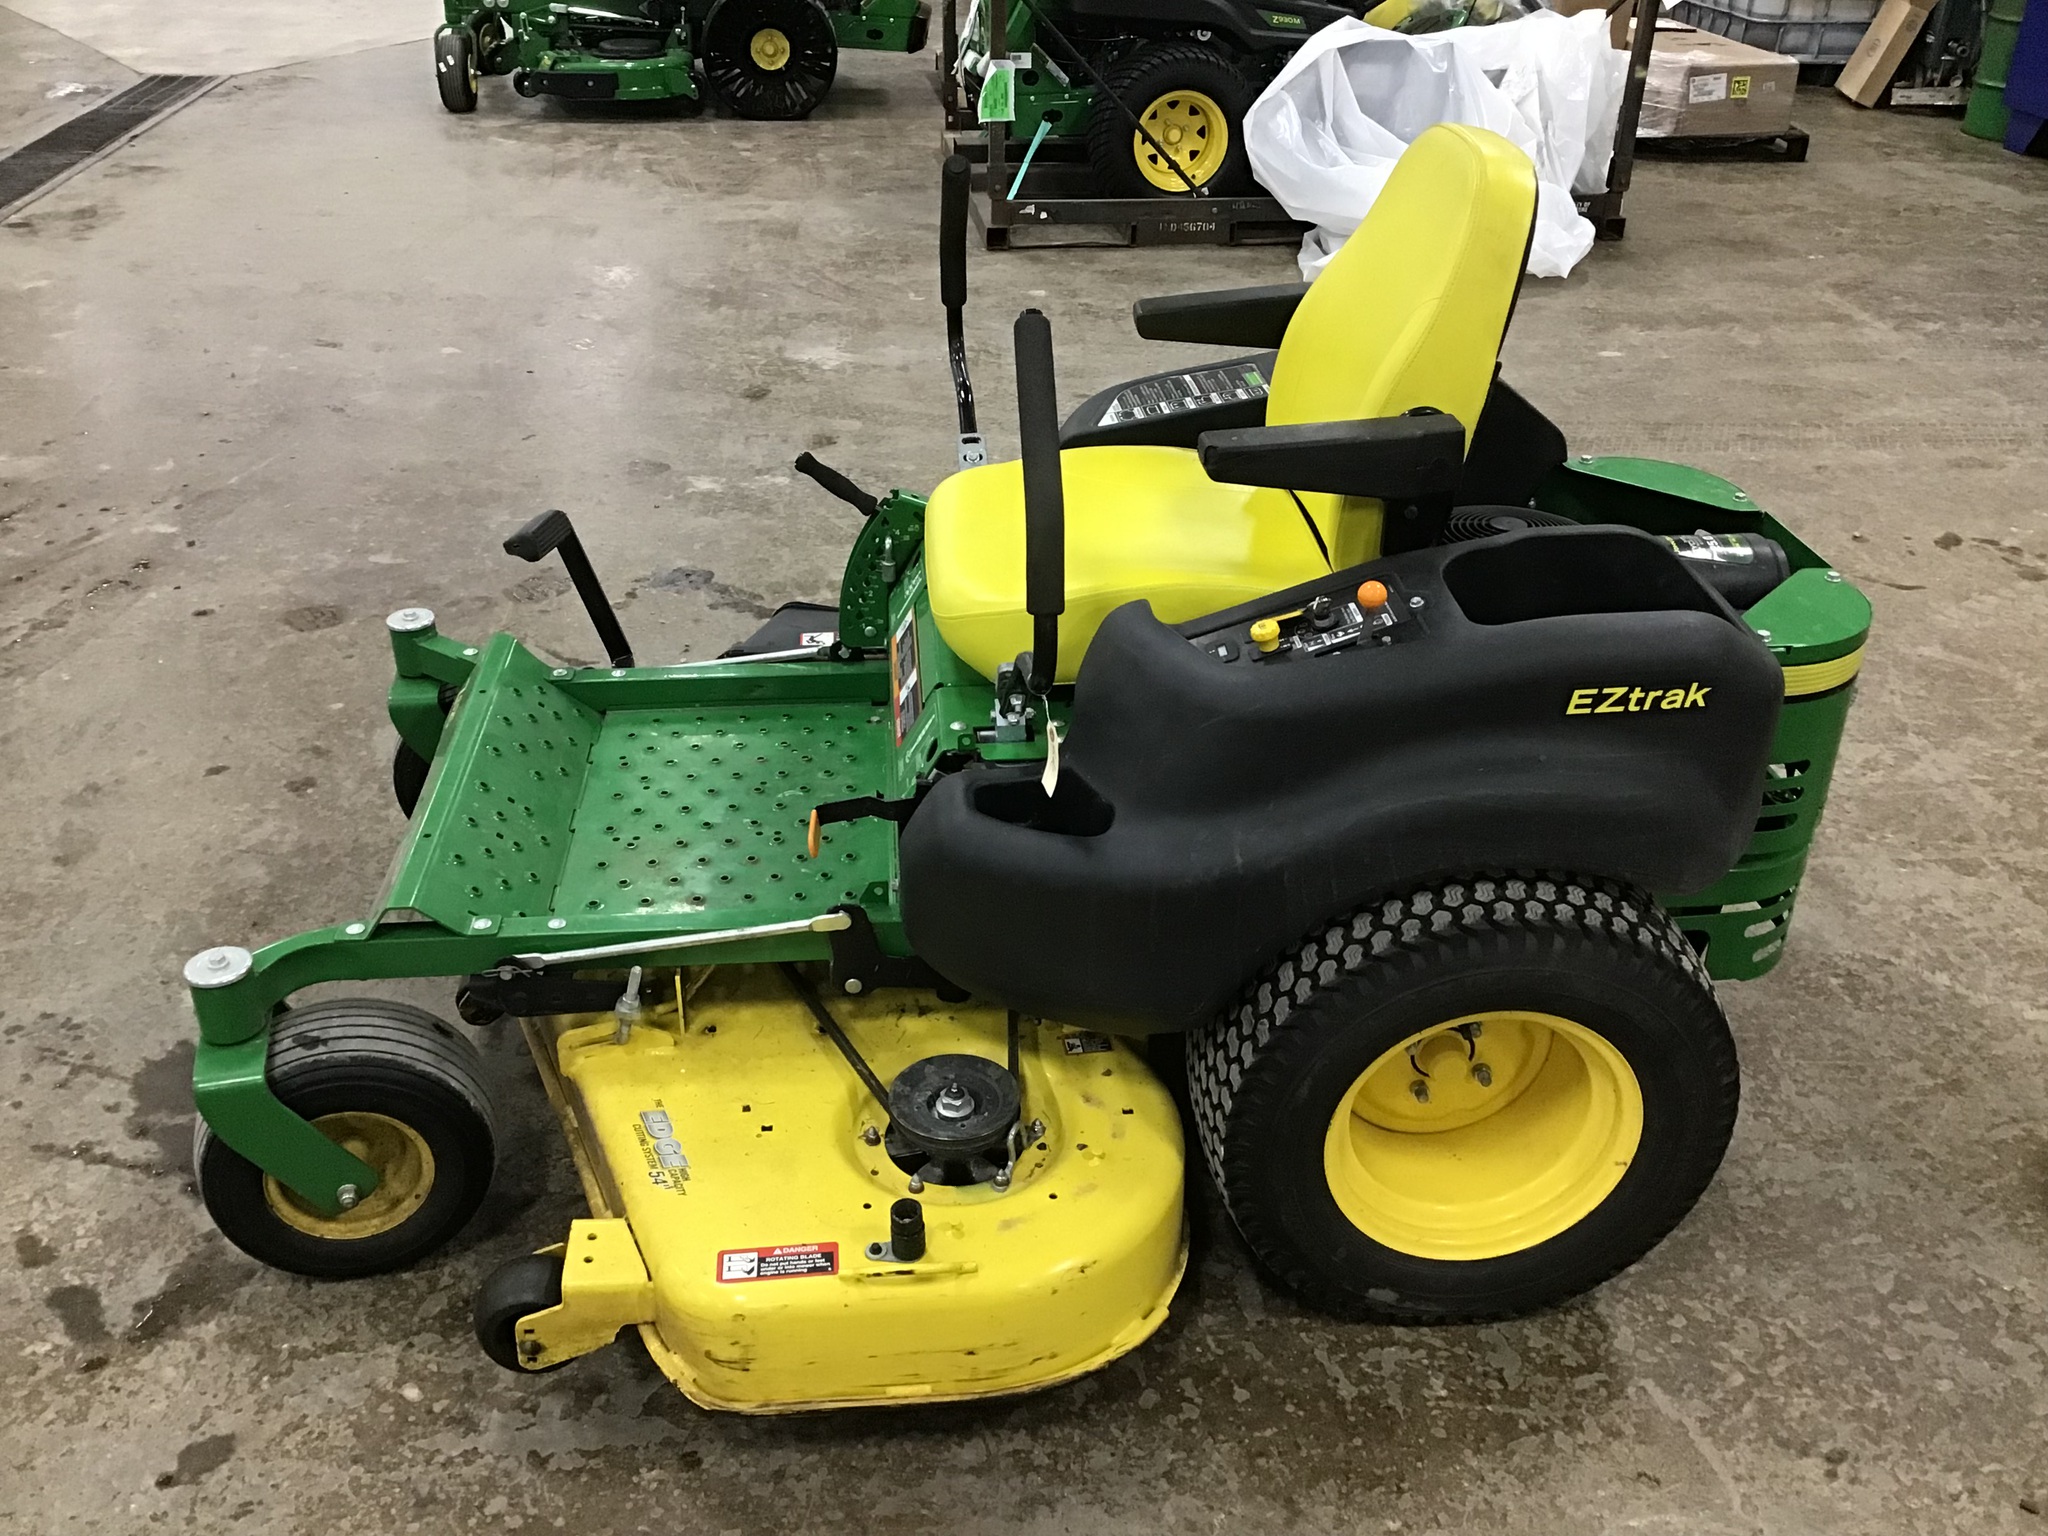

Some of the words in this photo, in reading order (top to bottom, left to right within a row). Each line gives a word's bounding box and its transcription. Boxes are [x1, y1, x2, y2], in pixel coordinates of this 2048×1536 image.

[1272, 15, 1300, 24] Z930M
[1565, 682, 1712, 715] EZtrak
[632, 1123, 649, 1147] CUTTING
[642, 1146, 658, 1170] SYSTEM
[640, 1110, 689, 1169] EDGE
[668, 1168, 687, 1196] CAPACITY
[783, 1245, 818, 1253] DANGER
